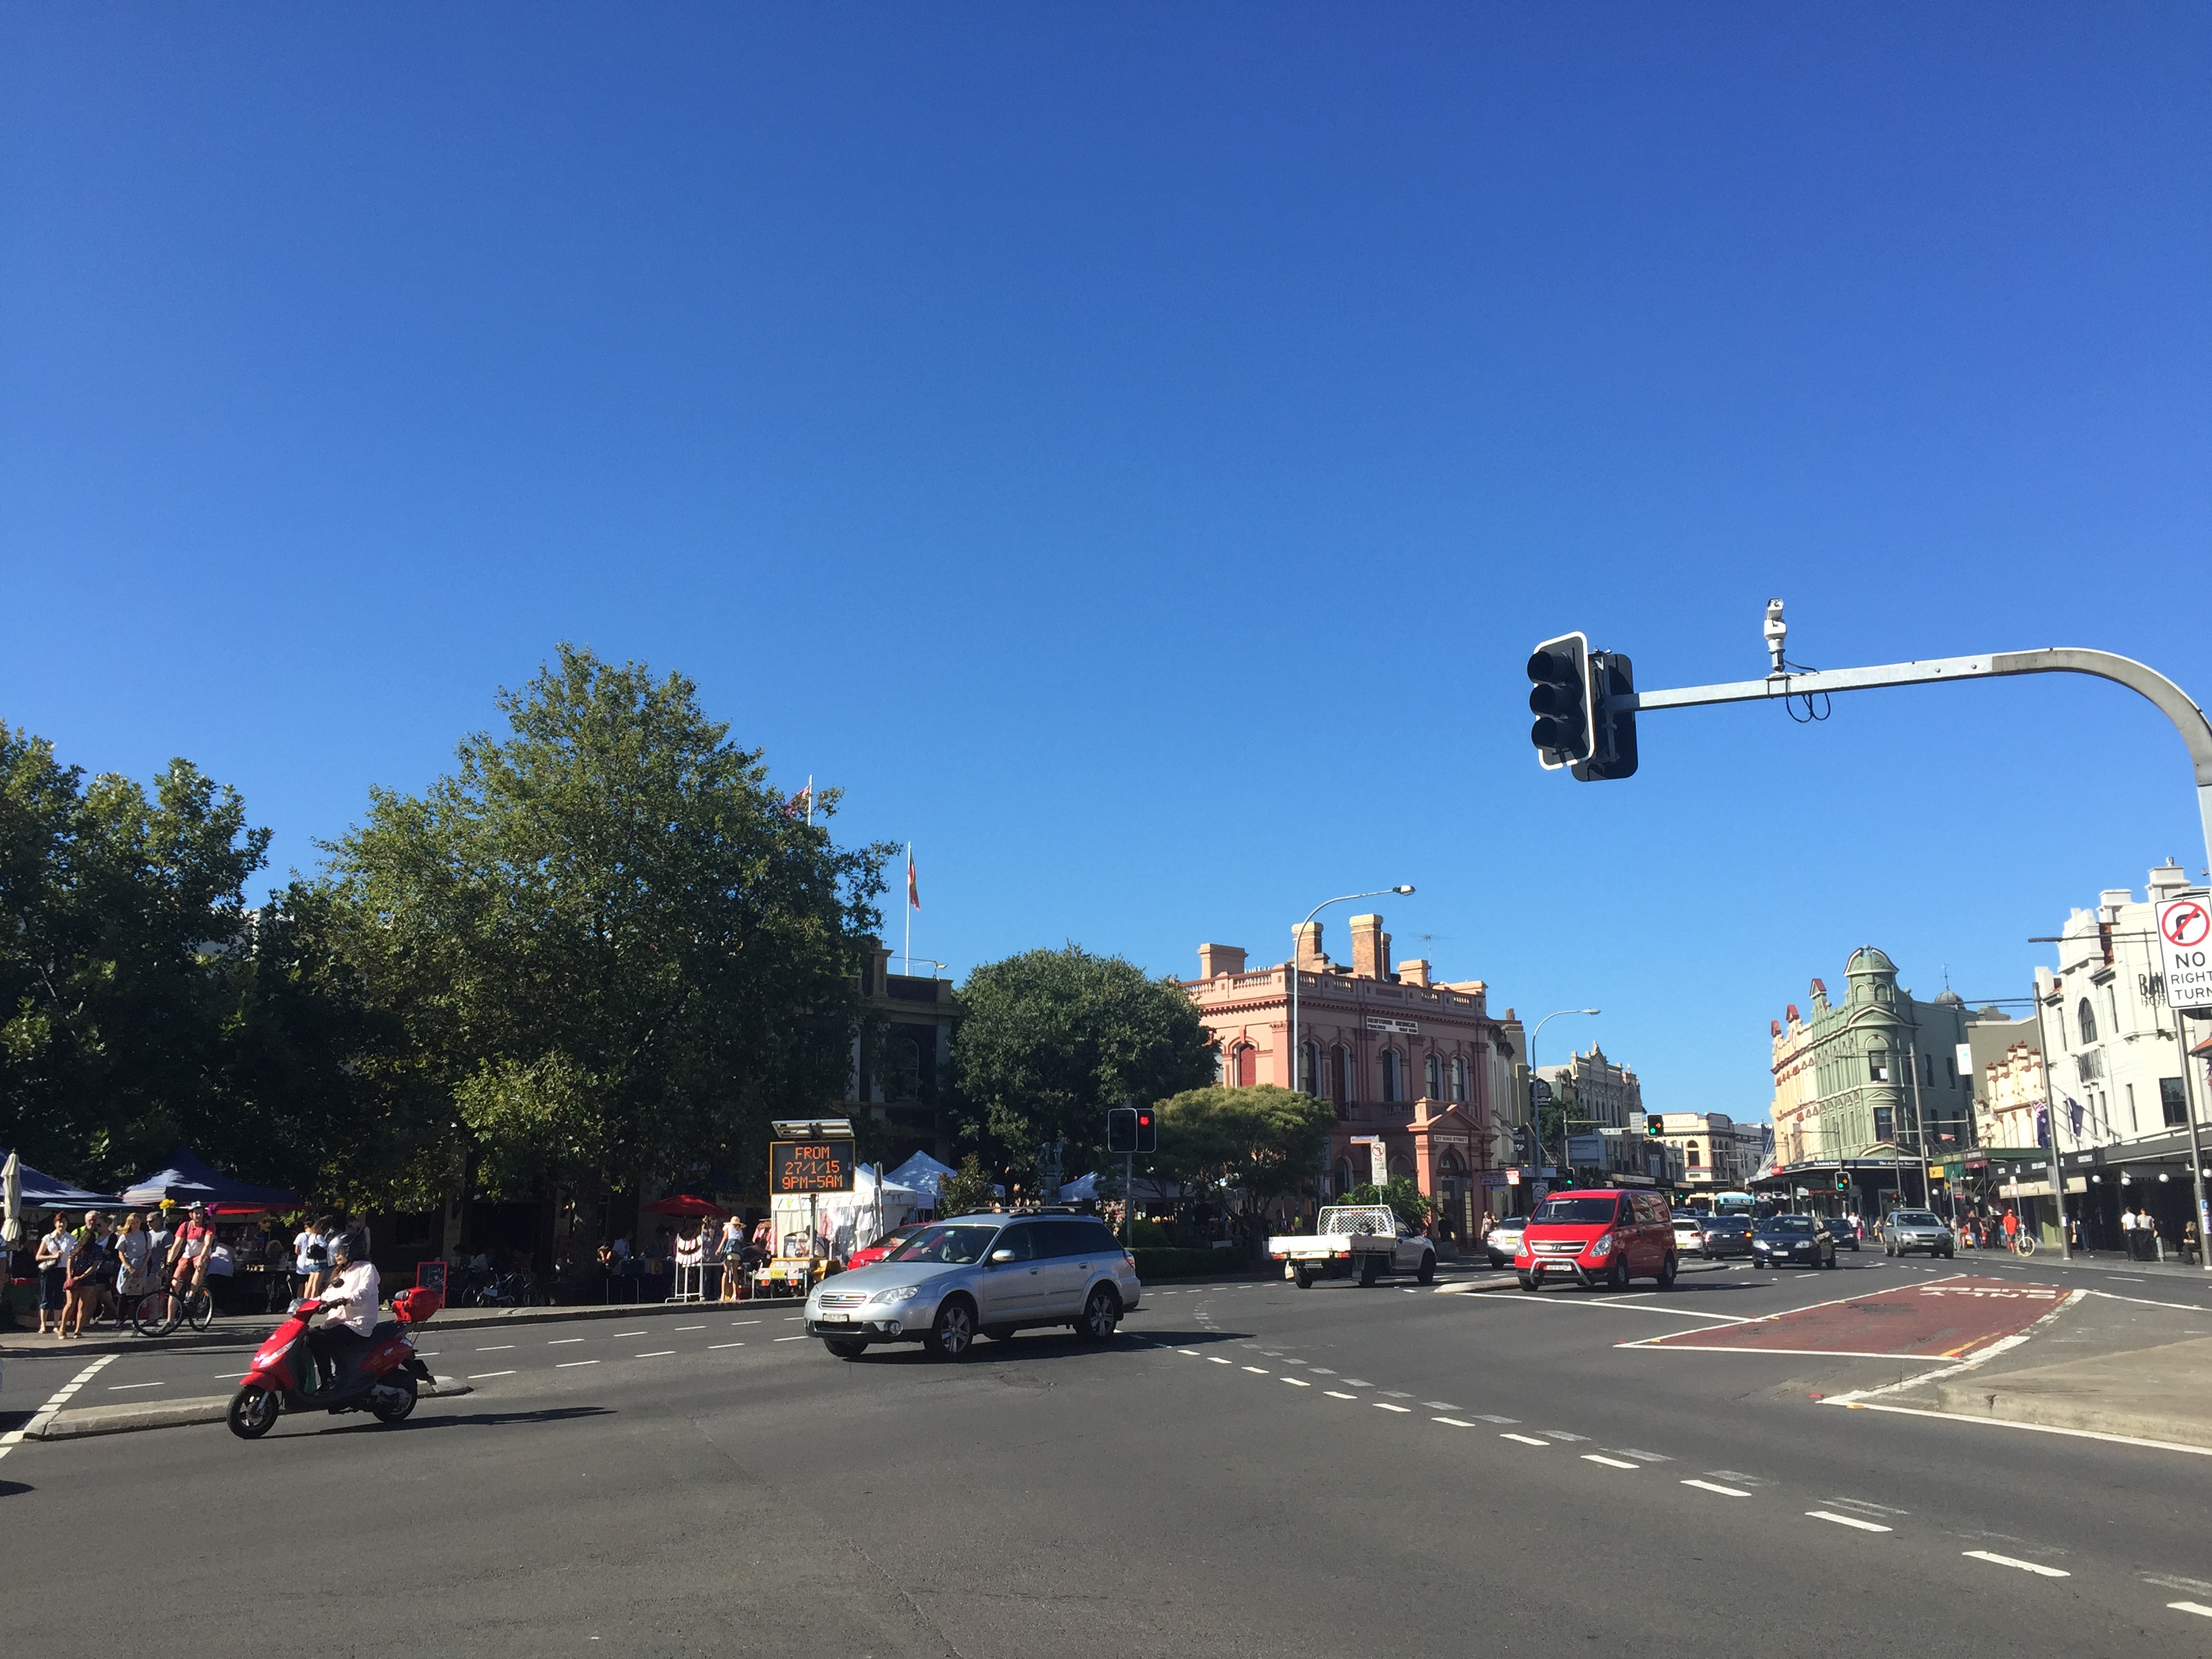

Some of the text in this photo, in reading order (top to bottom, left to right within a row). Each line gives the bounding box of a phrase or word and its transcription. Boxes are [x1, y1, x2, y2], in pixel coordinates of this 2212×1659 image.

[2175, 951, 2206, 969] NO
[794, 1146, 830, 1160] FROM
[785, 1160, 840, 1176] 27/1/15
[781, 1174, 843, 1190] 9PM-5AM
